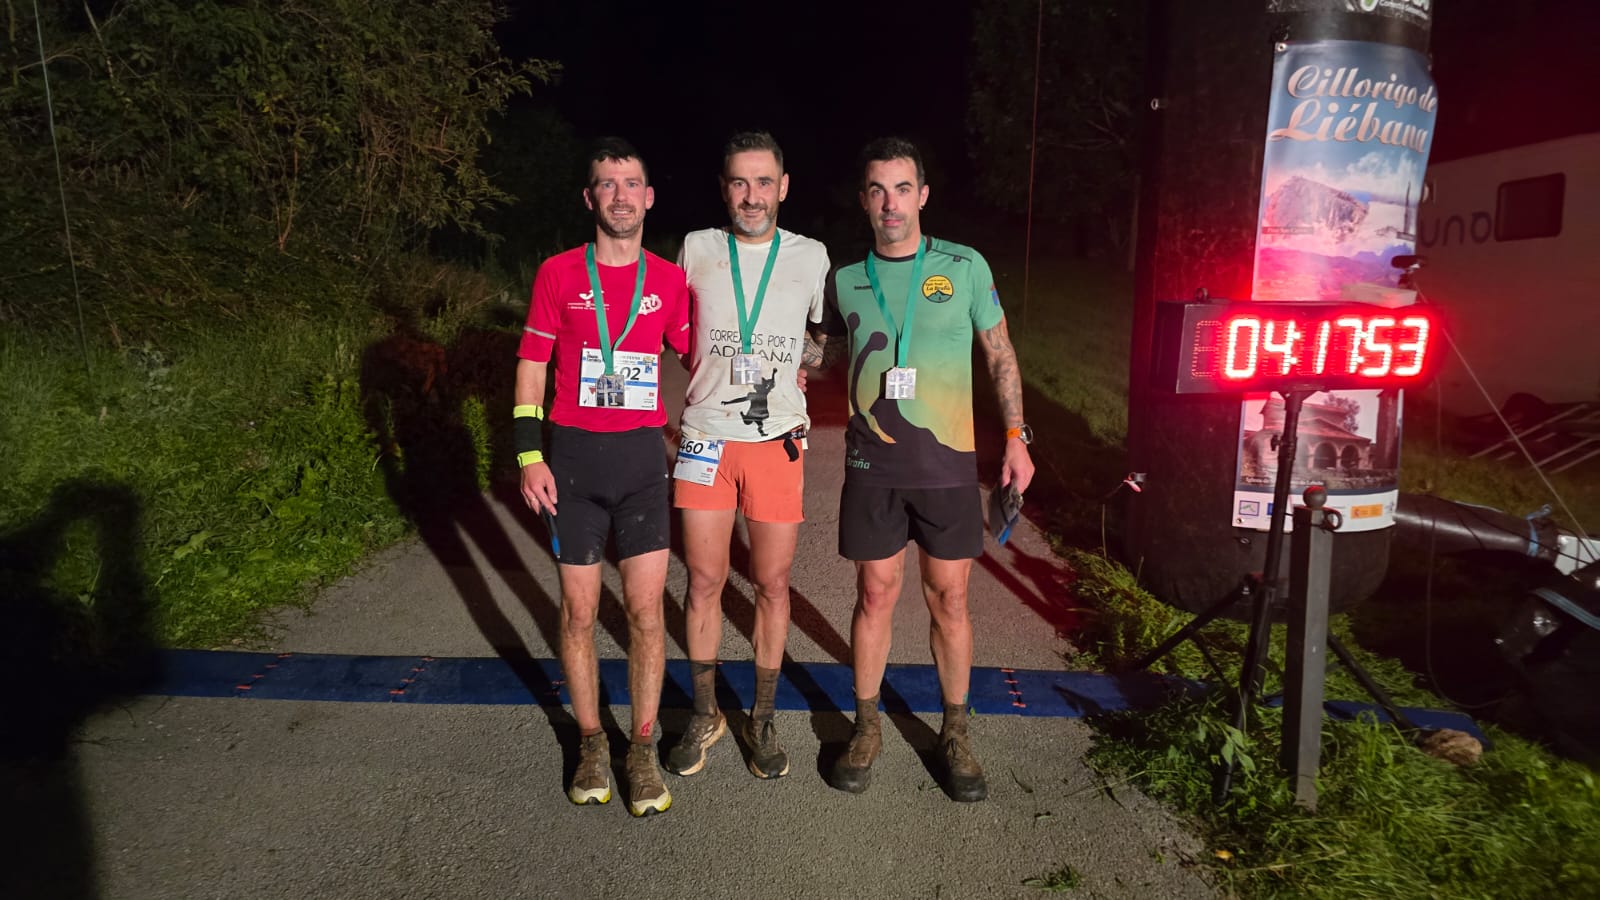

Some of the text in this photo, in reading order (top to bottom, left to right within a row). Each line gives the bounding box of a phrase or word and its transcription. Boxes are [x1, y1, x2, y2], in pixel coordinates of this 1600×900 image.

[1288, 64, 1437, 113] Cillorigo de
[1270, 98, 1428, 153] Liébana
[709, 328, 797, 350] CORREOS POR TI
[679, 439, 704, 455] 460
